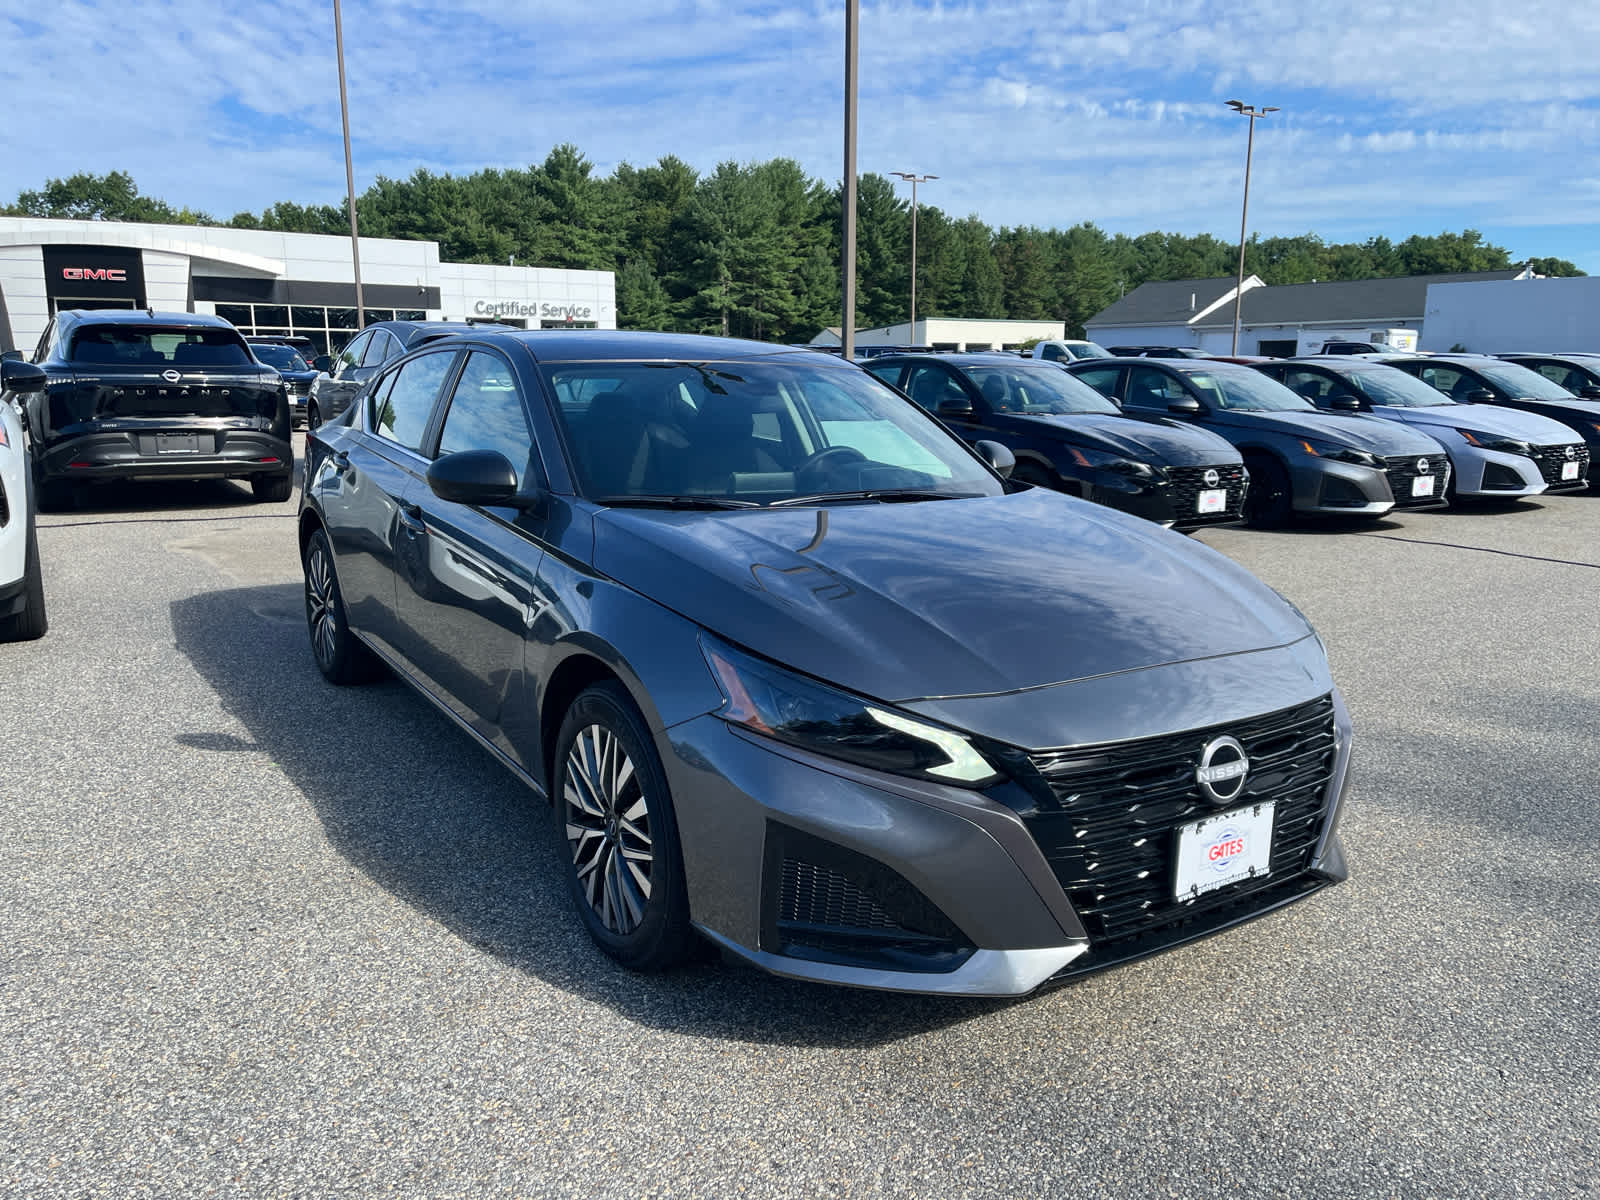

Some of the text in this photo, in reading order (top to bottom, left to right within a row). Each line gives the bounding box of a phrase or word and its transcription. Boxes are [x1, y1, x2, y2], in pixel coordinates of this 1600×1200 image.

[63, 268, 126, 281] GMC
[474, 300, 592, 318] Certified Service
[113, 389, 231, 397] MURANO
[1199, 761, 1249, 783] NISSAN
[1208, 839, 1243, 861] GATES
